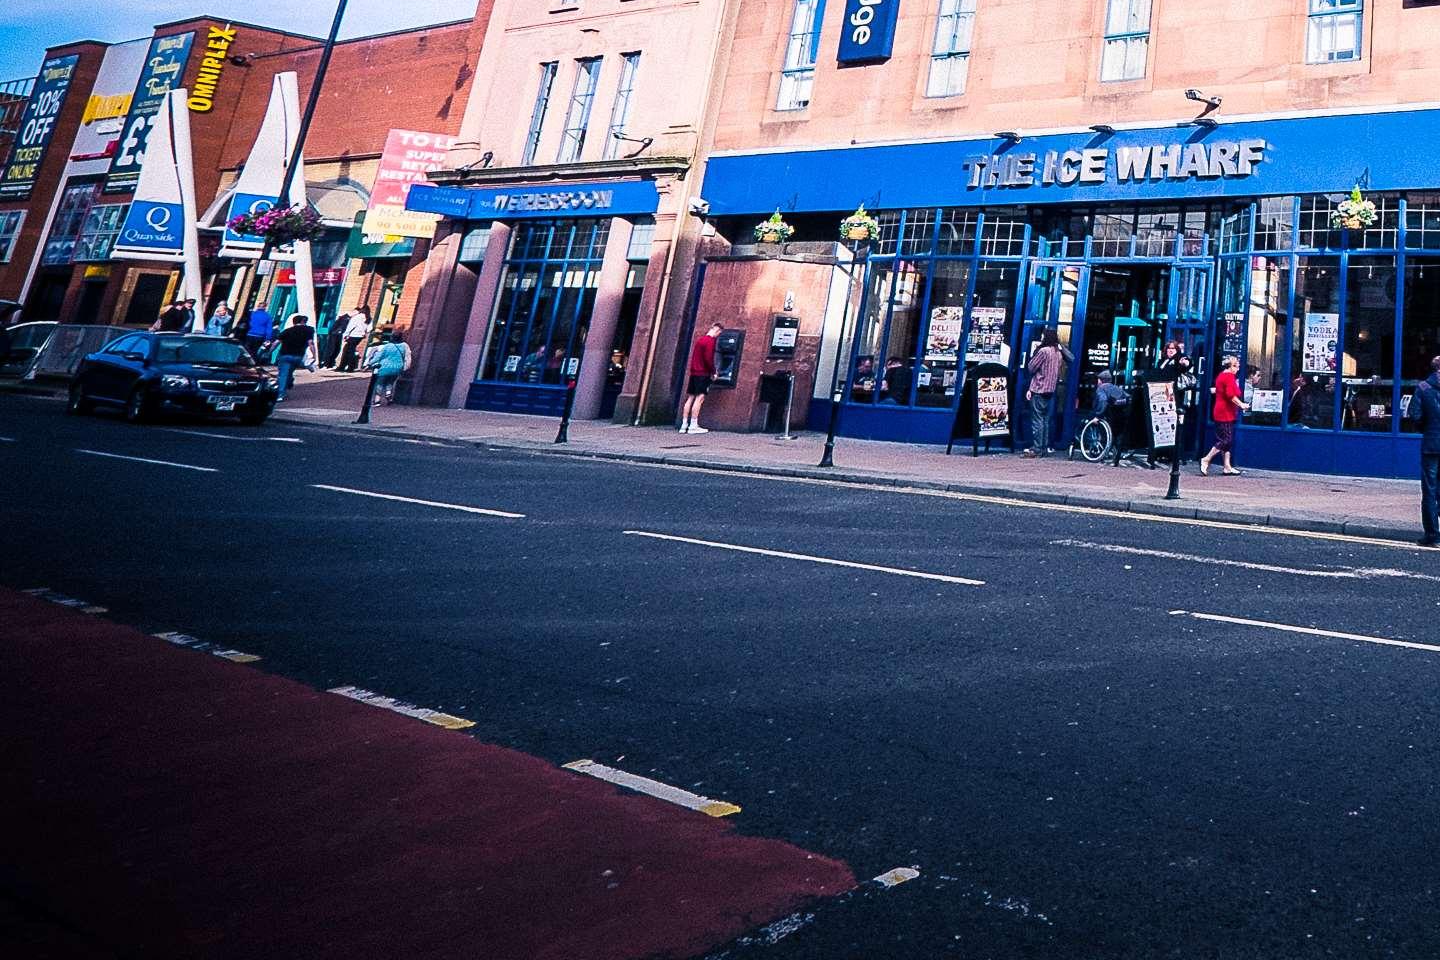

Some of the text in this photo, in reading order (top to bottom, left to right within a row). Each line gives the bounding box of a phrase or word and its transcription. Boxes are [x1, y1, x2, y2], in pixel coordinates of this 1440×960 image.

[187, 24, 237, 111] OMNIPLEX
[22, 116, 55, 146] OFF
[400, 133, 430, 147] TO
[14, 147, 43, 162] TICKETS
[964, 139, 1267, 189] THE ICE WHARF
[7, 164, 37, 180] ONLINE
[146, 207, 171, 232] Q
